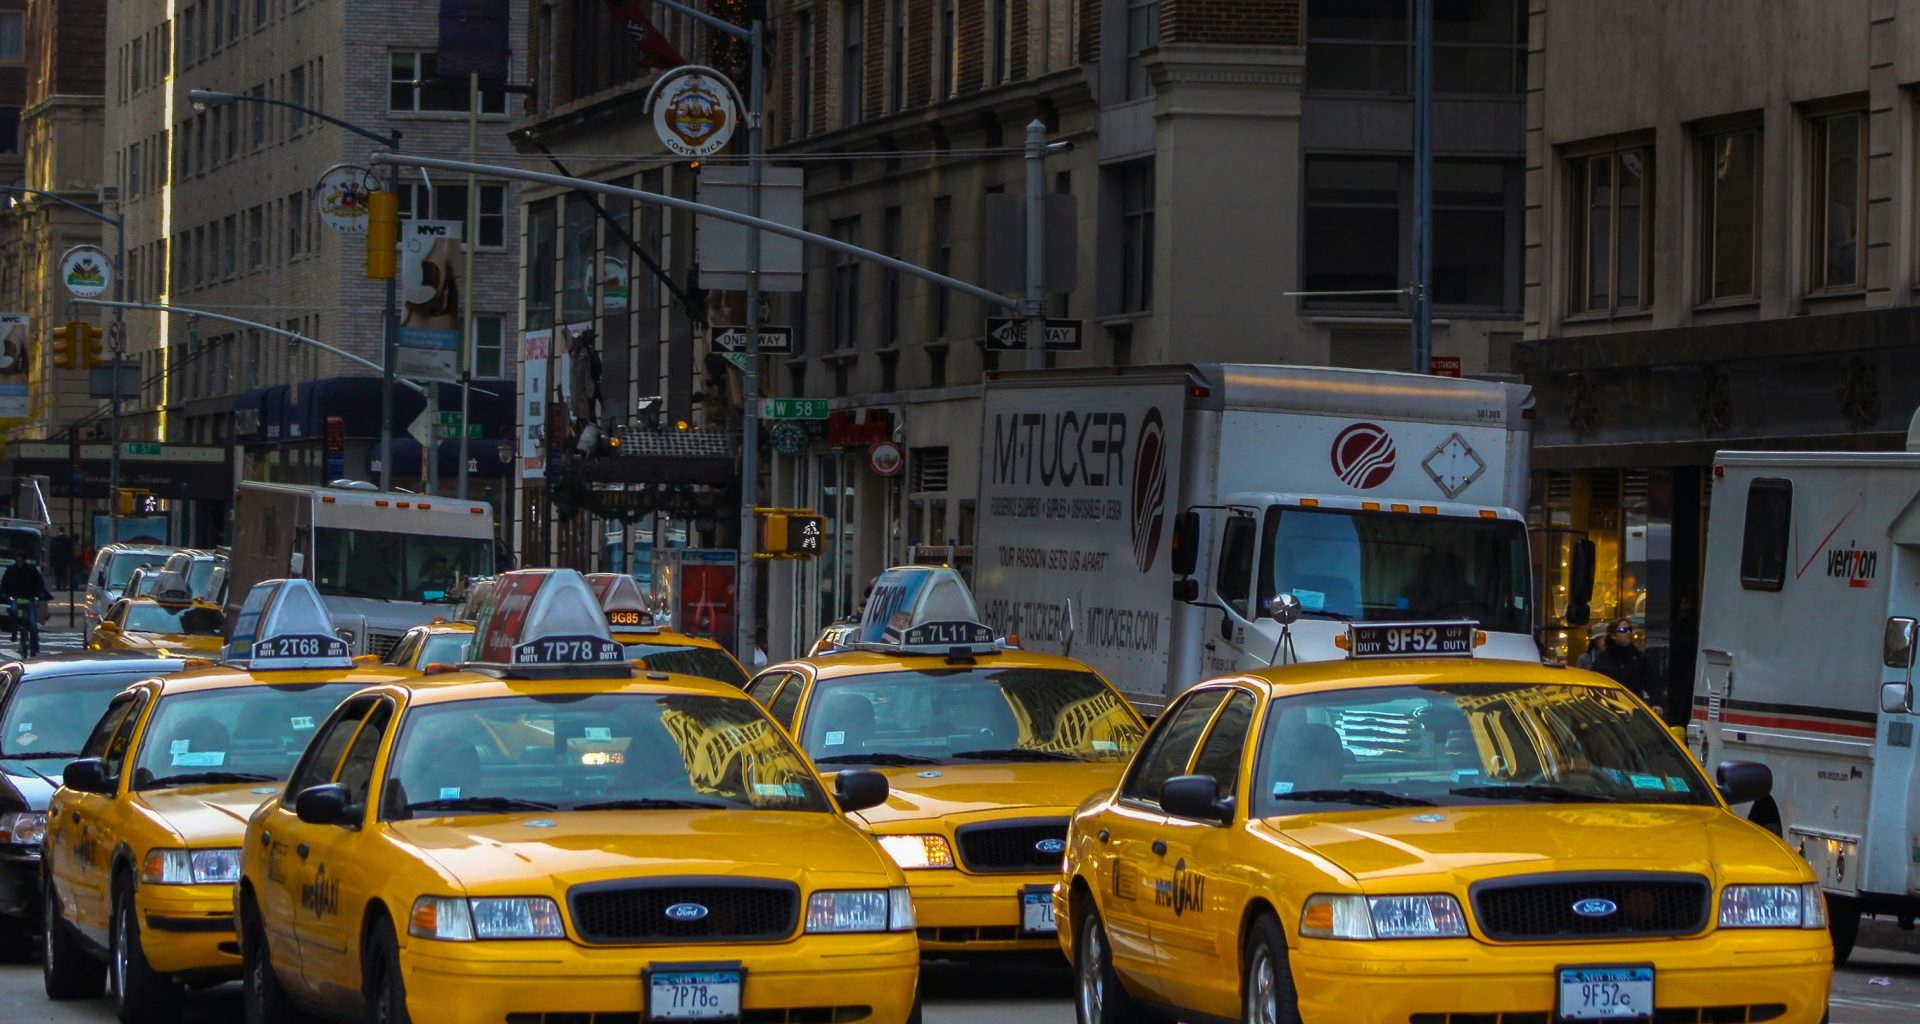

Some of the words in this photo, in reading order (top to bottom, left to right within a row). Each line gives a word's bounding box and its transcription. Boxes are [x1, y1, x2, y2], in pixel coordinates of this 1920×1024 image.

[667, 138, 697, 155] COSTA
[700, 139, 723, 155] RICA
[418, 225, 446, 235] NYC
[1000, 327, 1026, 340] ONE
[723, 334, 747, 346] ONE
[775, 402, 787, 417] W
[795, 401, 813, 417] 58
[816, 401, 826, 409] ST
[1015, 548, 1046, 569] PASSION
[1048, 549, 1068, 571] SETS
[1069, 550, 1080, 571] US
[1827, 539, 1877, 588] verizon
[867, 585, 907, 625] TOKYO
[611, 612, 639, 624] 9G85
[928, 625, 968, 642] 7L11
[1361, 631, 1377, 639] OFF
[1446, 627, 1463, 637] OFF
[1387, 628, 1438, 652] 9F52
[1443, 640, 1467, 650] DUTY
[280, 639, 319, 656] 2T68
[328, 648, 343, 656] DUTY
[522, 646, 535, 654] OFF
[544, 641, 593, 661] 7P78
[602, 643, 614, 651] OFF
[1357, 642, 1380, 652] DUTY
[520, 654, 538, 662] DUTY
[600, 651, 618, 660] DUTY
